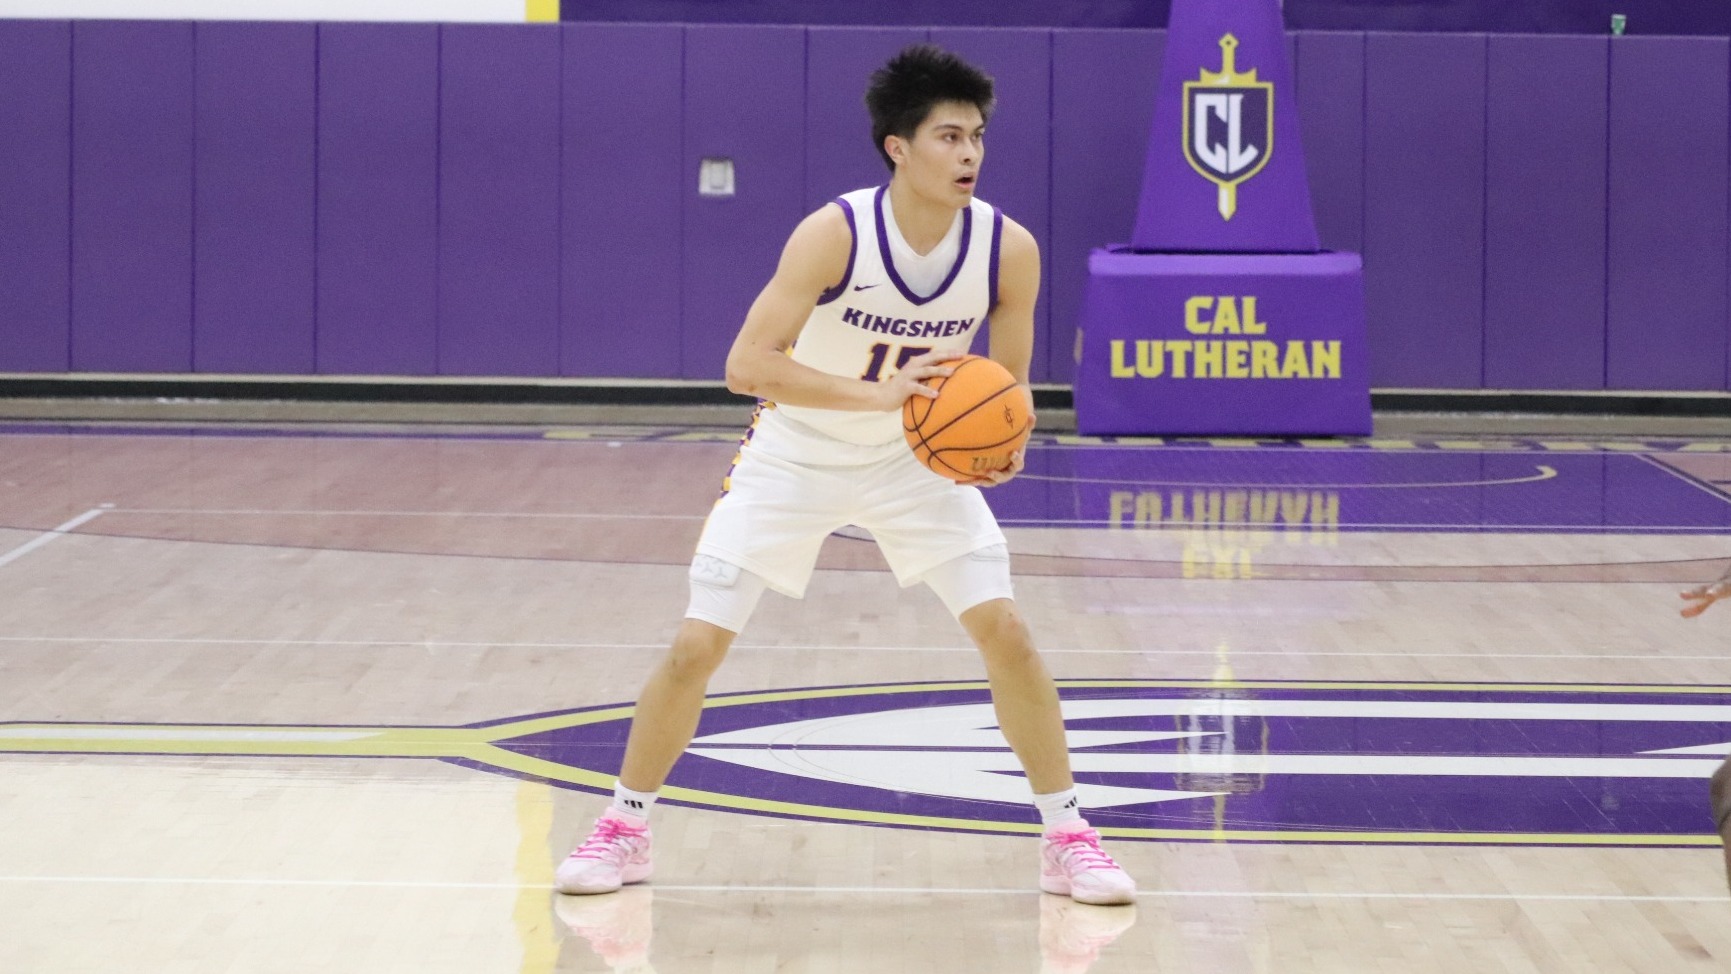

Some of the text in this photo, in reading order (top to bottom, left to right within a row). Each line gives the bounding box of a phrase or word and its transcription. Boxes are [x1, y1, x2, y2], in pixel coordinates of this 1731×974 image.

[1194, 93, 1259, 175] CL
[842, 307, 975, 338] KINGSMEN
[1184, 296, 1267, 334] CAL
[1110, 340, 1342, 379] LUTHERAN
